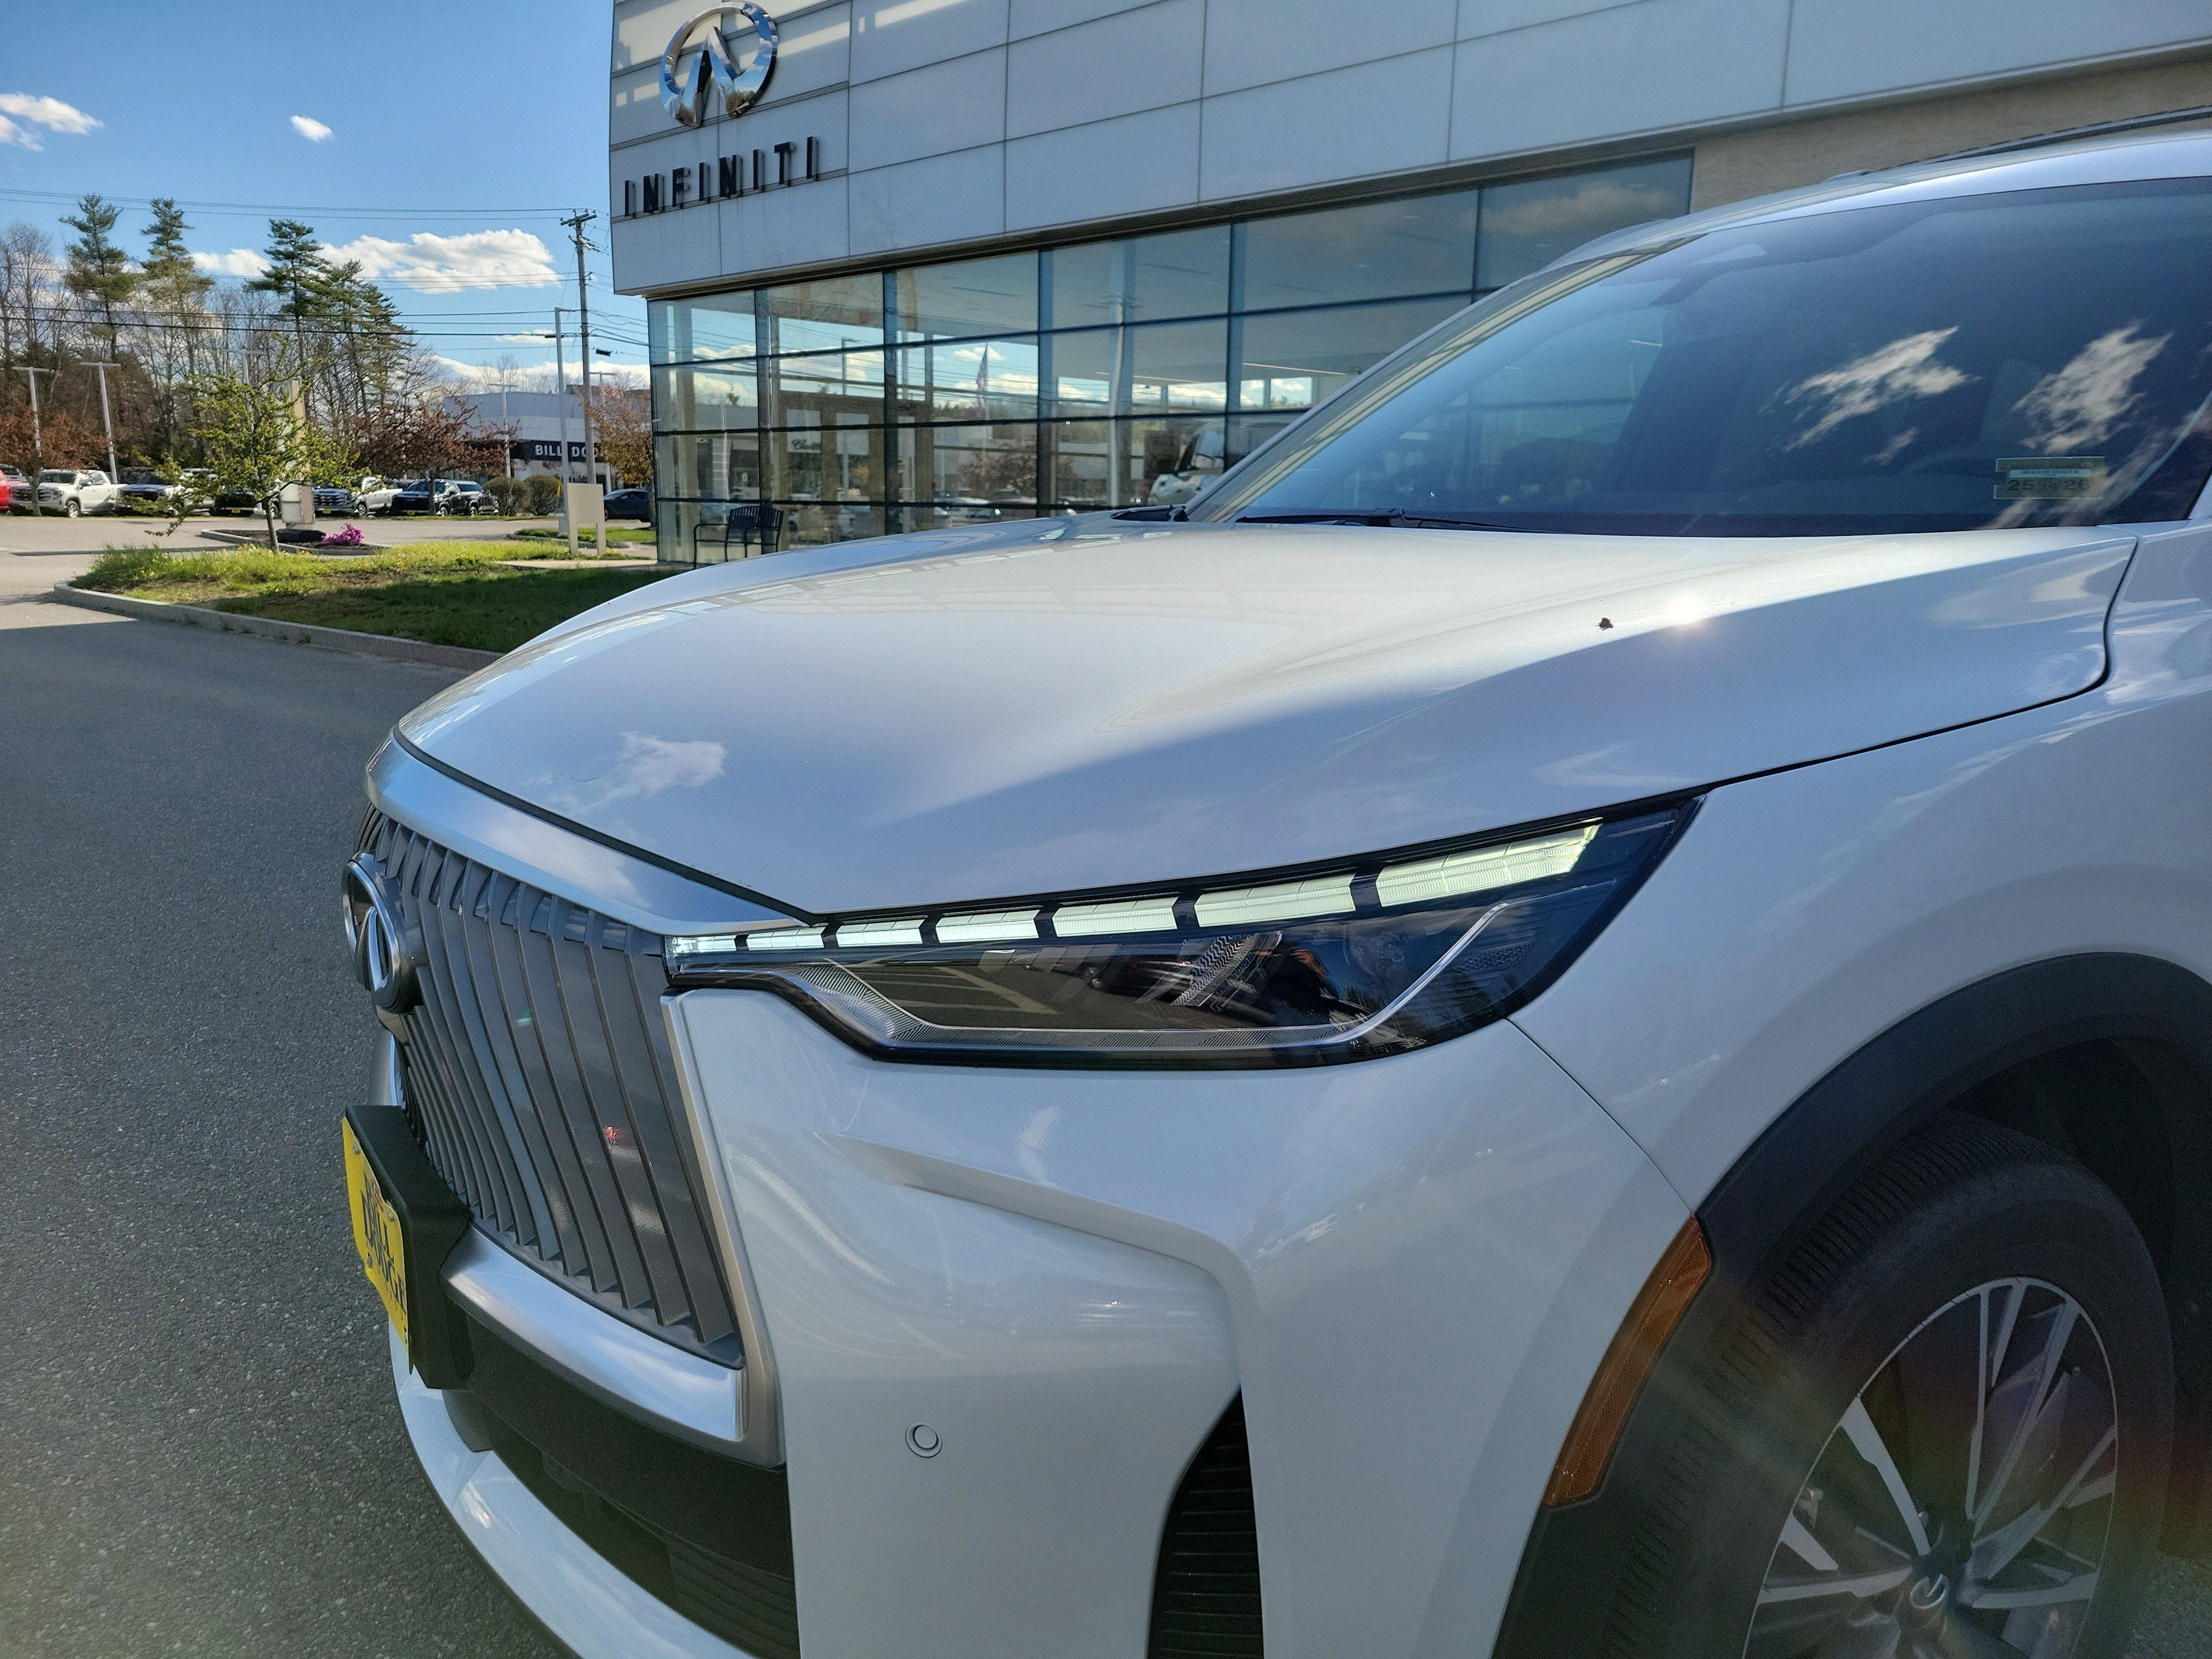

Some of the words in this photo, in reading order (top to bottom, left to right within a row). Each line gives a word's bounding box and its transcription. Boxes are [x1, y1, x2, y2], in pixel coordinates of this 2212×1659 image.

[624, 136, 819, 217] INFINITI
[535, 444, 563, 457] BILL
[2008, 479, 2035, 491] 25
